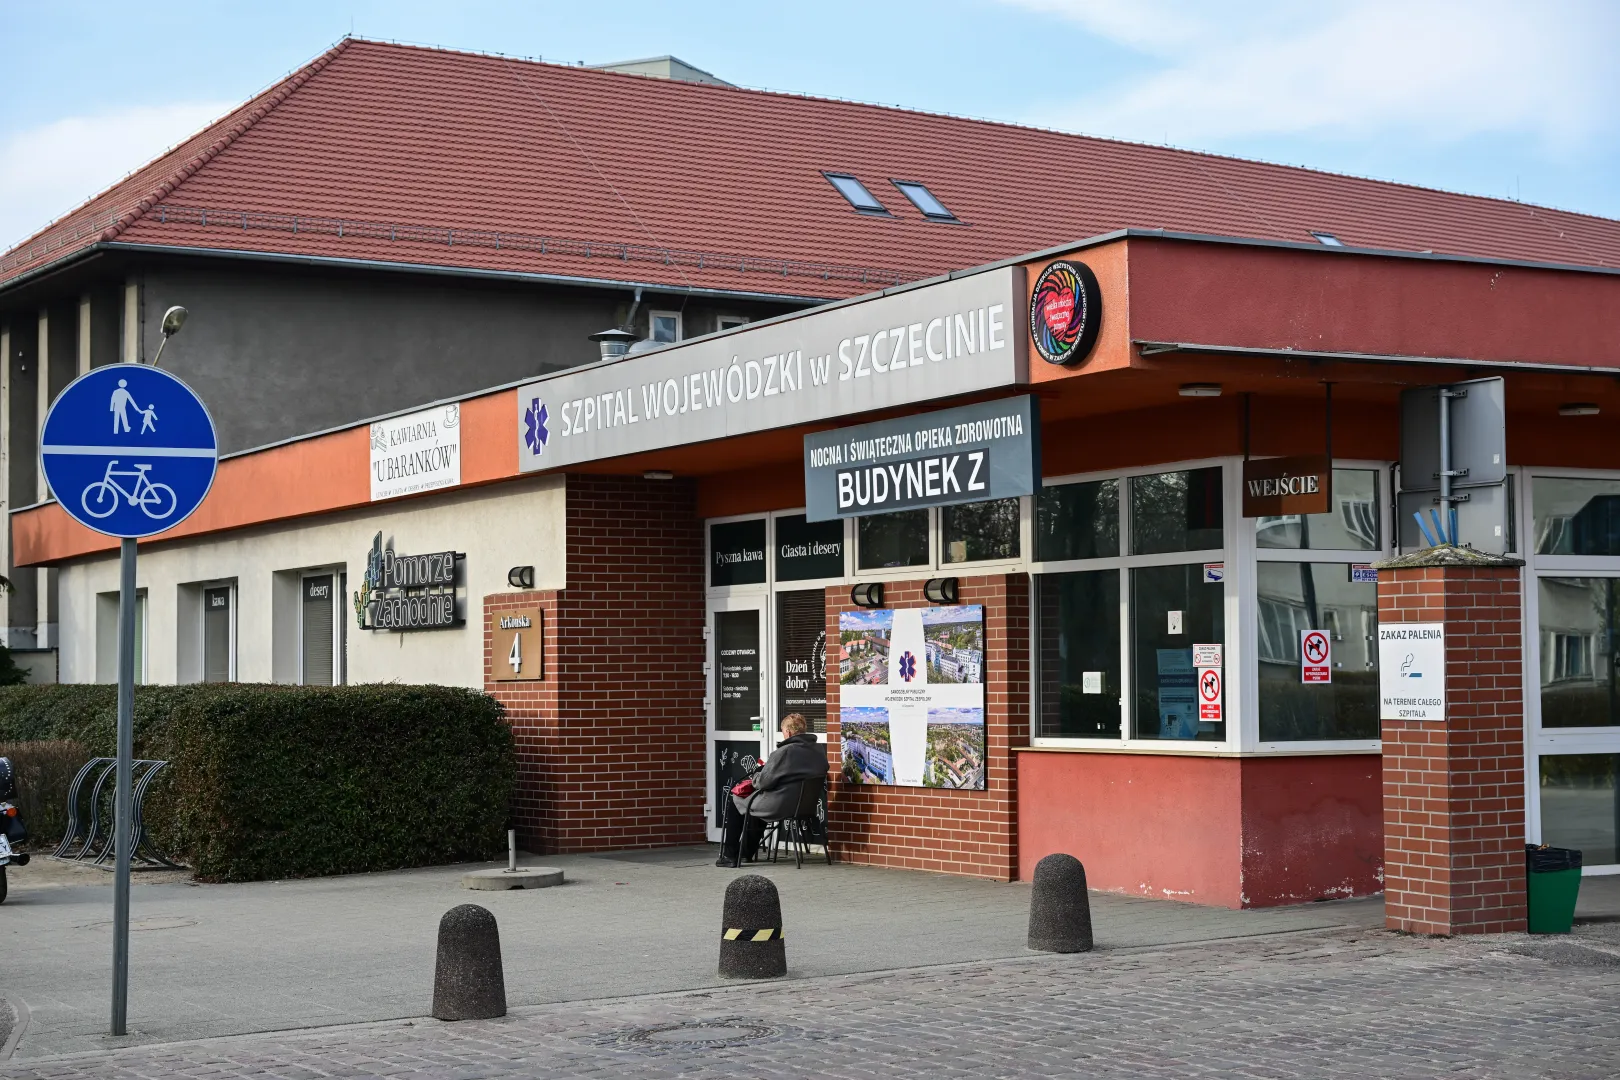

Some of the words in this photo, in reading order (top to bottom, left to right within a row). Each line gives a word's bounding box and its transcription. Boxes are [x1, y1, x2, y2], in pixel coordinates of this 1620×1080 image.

[561, 388, 639, 437] SZPITAL
[641, 350, 803, 421] WOJEWÓDZKI
[809, 354, 831, 387] w
[838, 303, 1005, 381] SZCZECINIE
[390, 420, 437, 446] KAWIARNIA
[810, 445, 842, 468] NOCNA
[844, 444, 848, 462] I
[850, 432, 913, 463] ŚWIĄTECZNA
[914, 426, 953, 451] OPIEKA
[955, 414, 1024, 445] ZDROWOTNA
[387, 439, 457, 480] BARANKÓW"
[838, 455, 962, 509] BUDYNEK
[967, 451, 985, 491] Z
[1247, 472, 1320, 497] WEJŚCIE
[716, 551, 741, 567] Pyszna
[743, 548, 763, 562] kawa
[781, 544, 807, 558] Ciasta
[808, 542, 811, 555] i
[813, 541, 841, 556] desery
[384, 550, 453, 586] Pomorze
[212, 594, 225, 606] kawa
[309, 582, 329, 599] desery
[375, 586, 453, 628] Zachodnie
[499, 614, 531, 629] Arkońska
[1380, 630, 1407, 640] ZAKAZ
[1408, 629, 1442, 640] PALENIA
[508, 632, 523, 673] 4
[785, 658, 808, 674] Dzień
[785, 676, 810, 692] dobry
[1383, 698, 1393, 706] NA
[1393, 698, 1417, 706] TERENIE
[1417, 698, 1442, 706] CAŁEGO
[1399, 709, 1427, 718] SZPITALA
